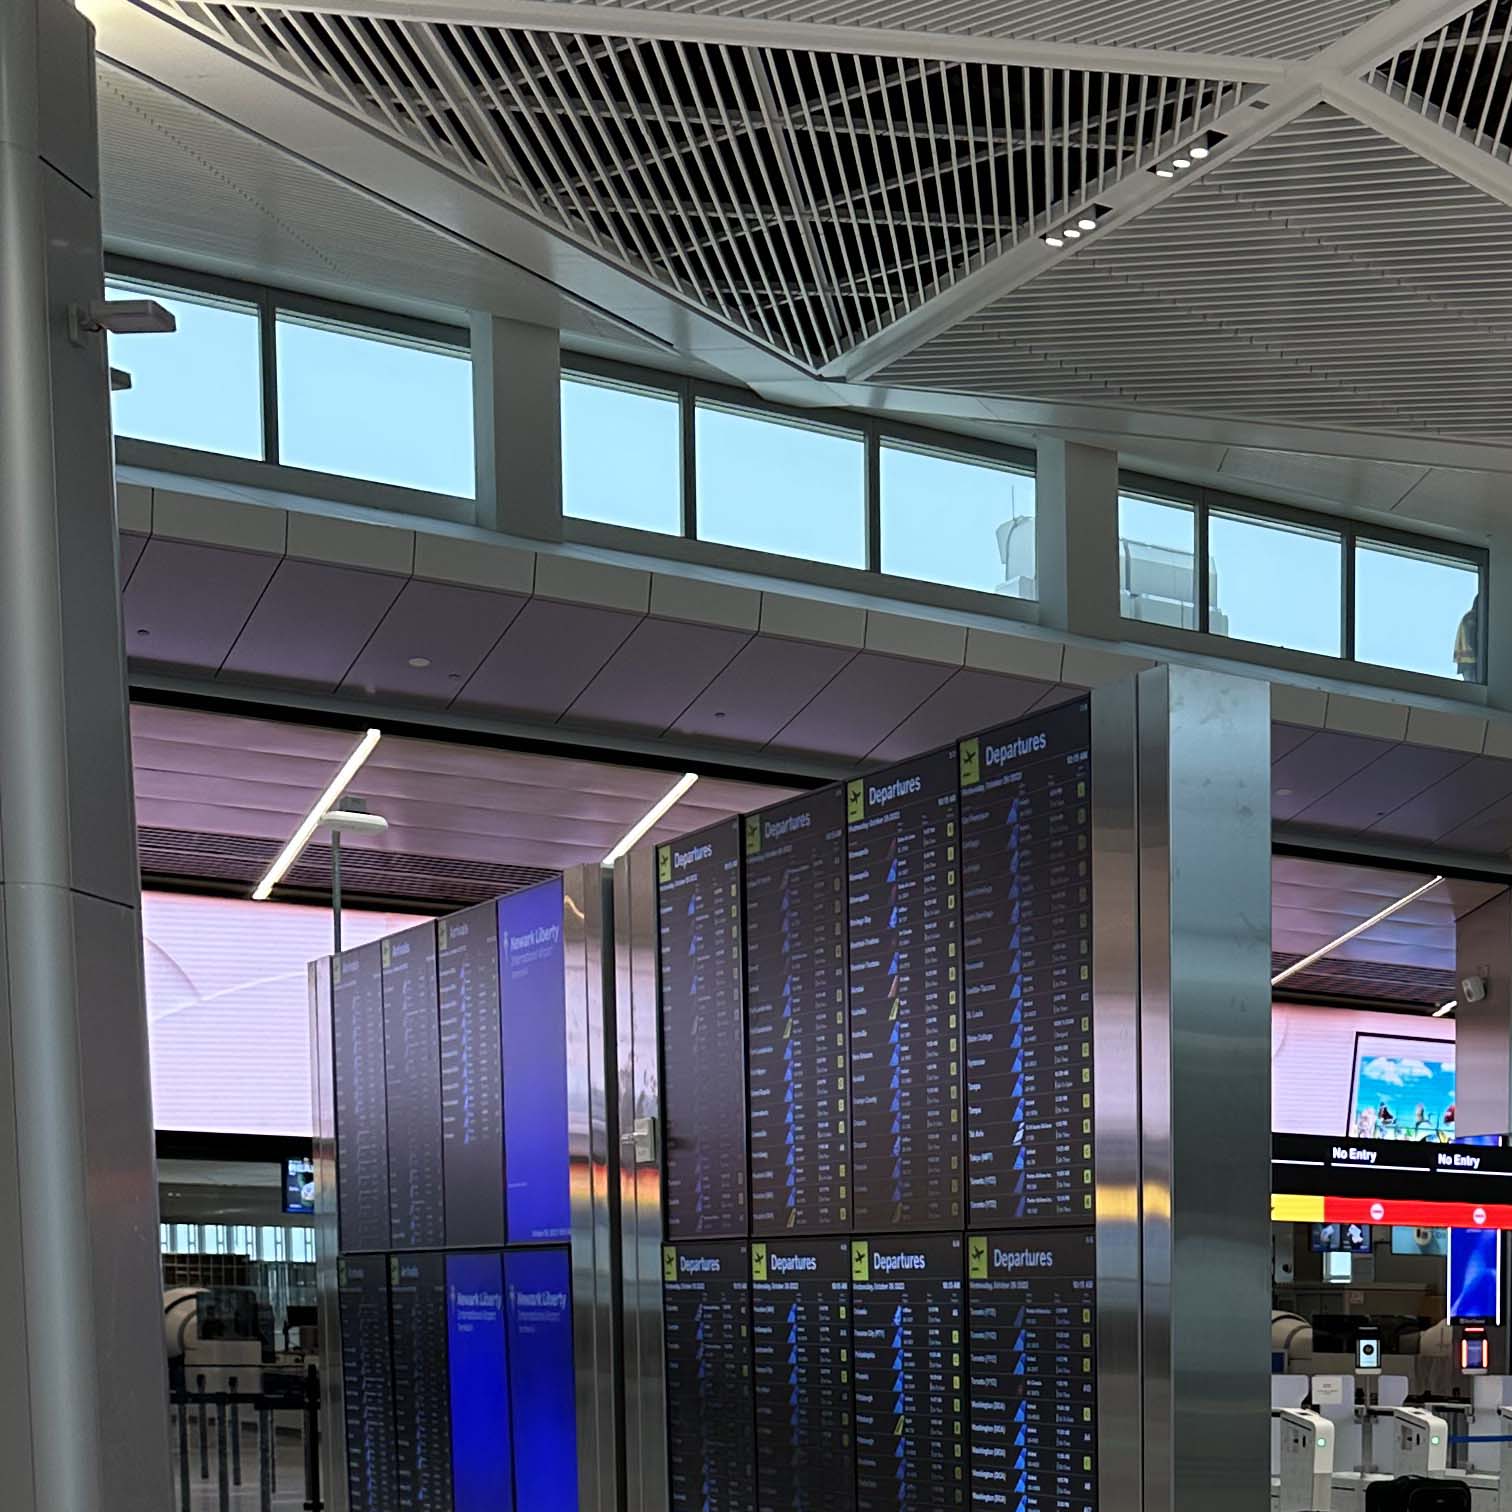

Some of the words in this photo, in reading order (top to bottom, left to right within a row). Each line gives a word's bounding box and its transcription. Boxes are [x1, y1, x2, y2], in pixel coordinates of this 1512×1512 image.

[985, 733, 1047, 766] Departures
[869, 776, 921, 806] Departures
[764, 812, 811, 840] Departures
[674, 844, 713, 870] Departures
[1332, 1147, 1347, 1160] No
[1348, 1148, 1377, 1164] Entry
[1437, 1153, 1452, 1166] No
[1454, 1154, 1480, 1169] Entry
[680, 1256, 721, 1276] Departures
[770, 1254, 817, 1275] Departures
[873, 1252, 926, 1274] Departures
[993, 1248, 1053, 1272] Departures
